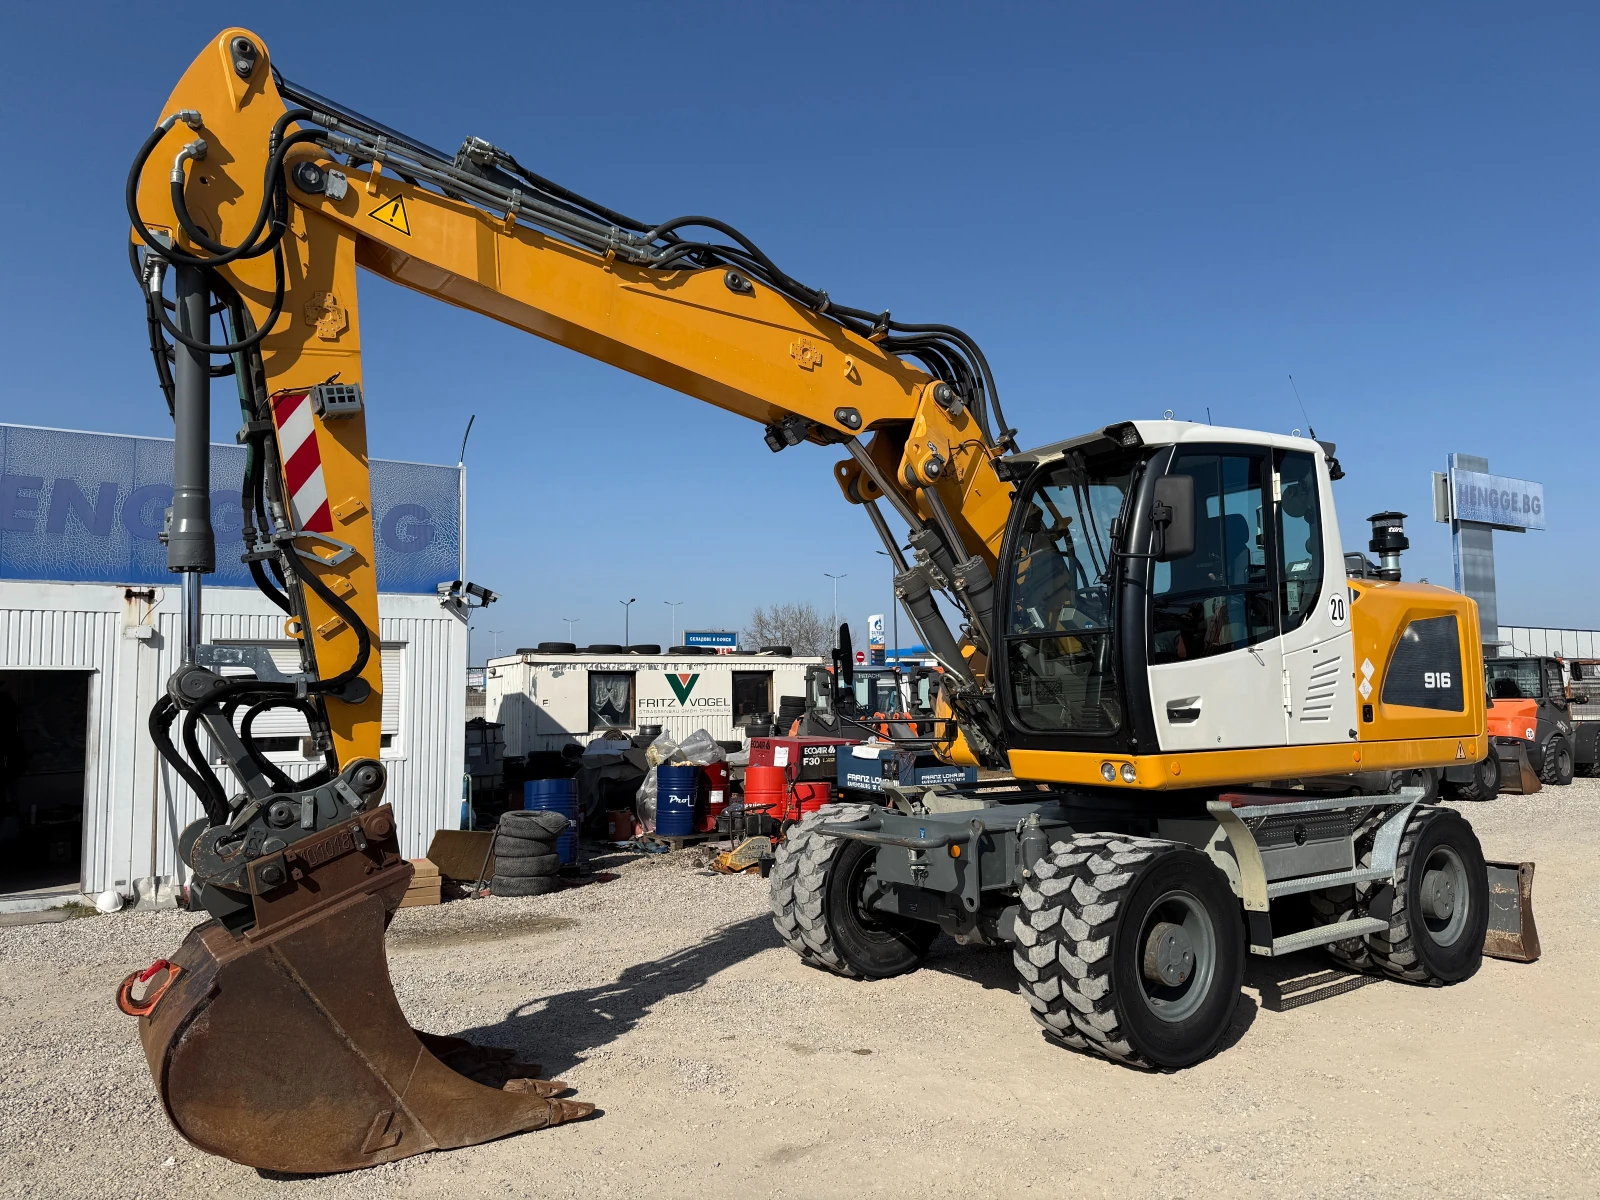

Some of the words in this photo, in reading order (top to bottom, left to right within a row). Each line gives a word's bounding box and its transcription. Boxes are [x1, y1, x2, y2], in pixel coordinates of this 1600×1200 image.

[1458, 484, 1541, 515] HENGGE.BG
[1330, 598, 1345, 621] 20
[1424, 672, 1451, 688] 916
[638, 698, 676, 708] FRITZ
[689, 697, 731, 707] VOGEL
[803, 747, 828, 755] ECOAIR
[803, 757, 821, 766] F30
[847, 773, 870, 783] FRANZ
